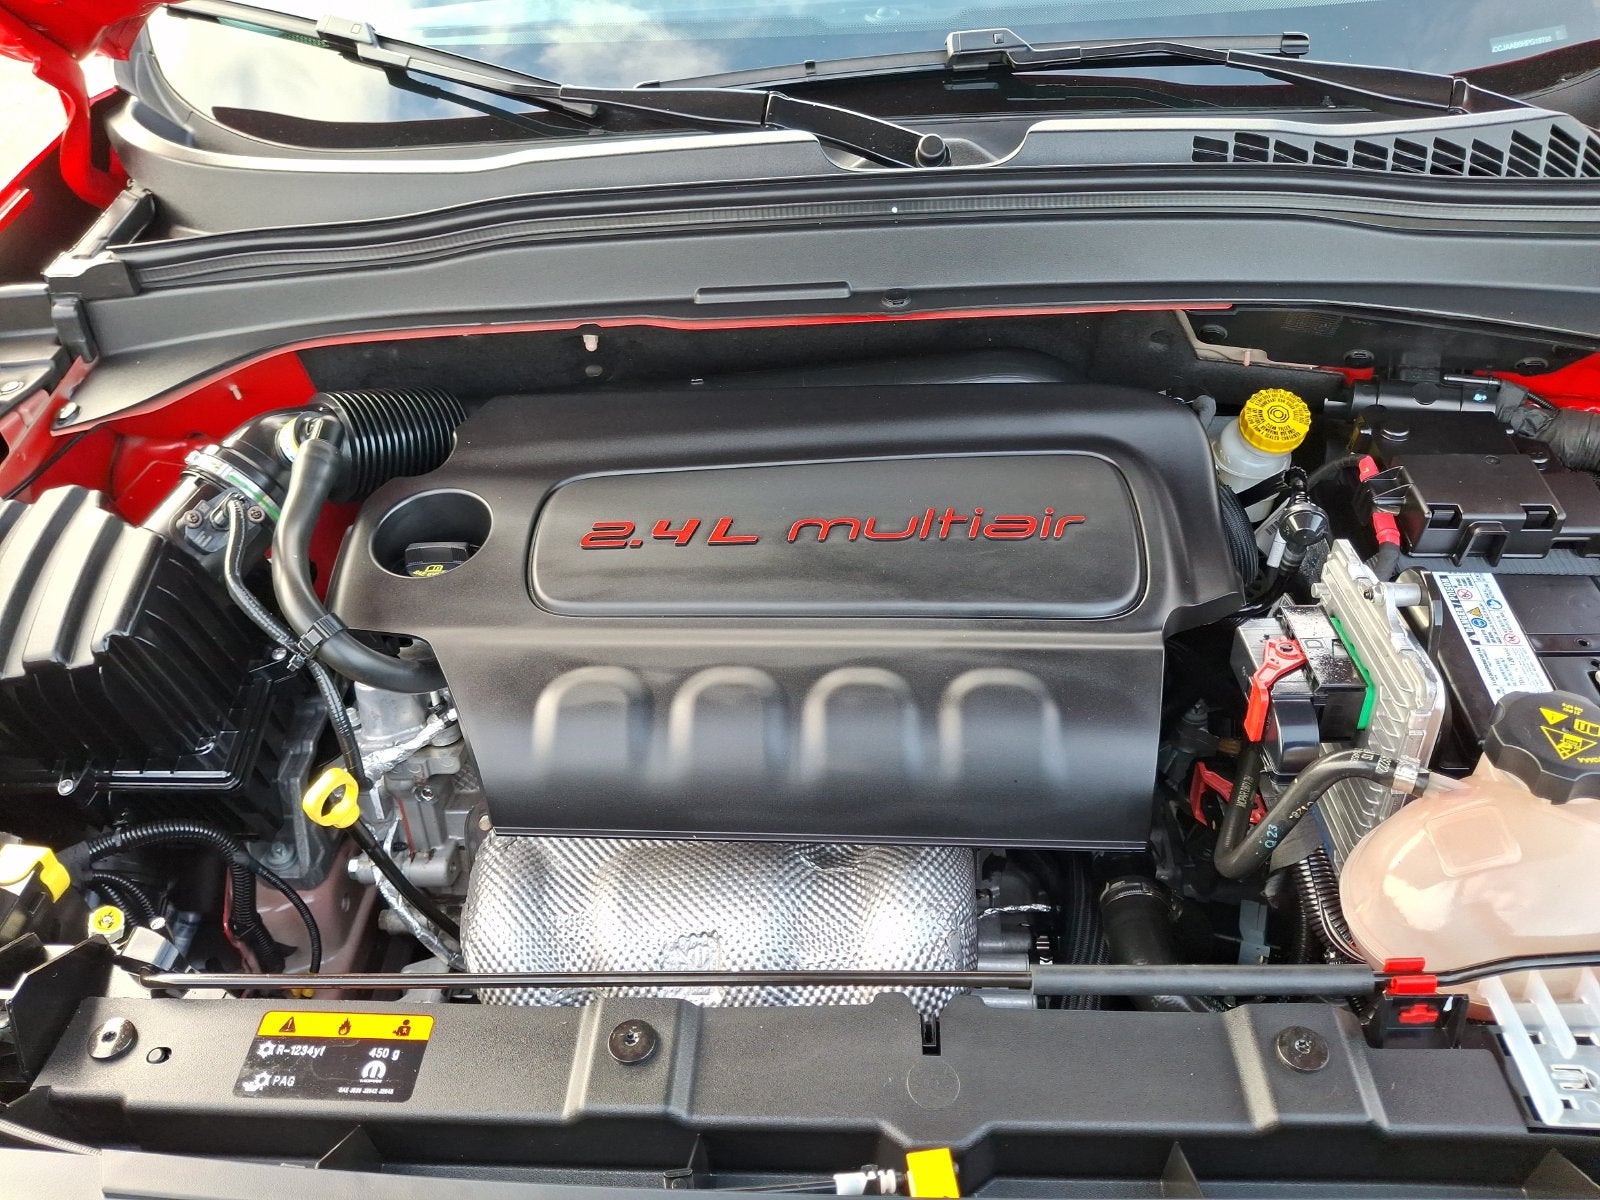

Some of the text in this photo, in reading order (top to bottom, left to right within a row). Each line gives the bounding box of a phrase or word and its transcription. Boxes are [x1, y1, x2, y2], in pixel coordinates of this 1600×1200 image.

[787, 507, 1086, 544] multiair
[1440, 578, 1459, 600] POISON
[275, 1045, 401, 1061] R-1234yf 450 g
[272, 1075, 296, 1087] PAG
